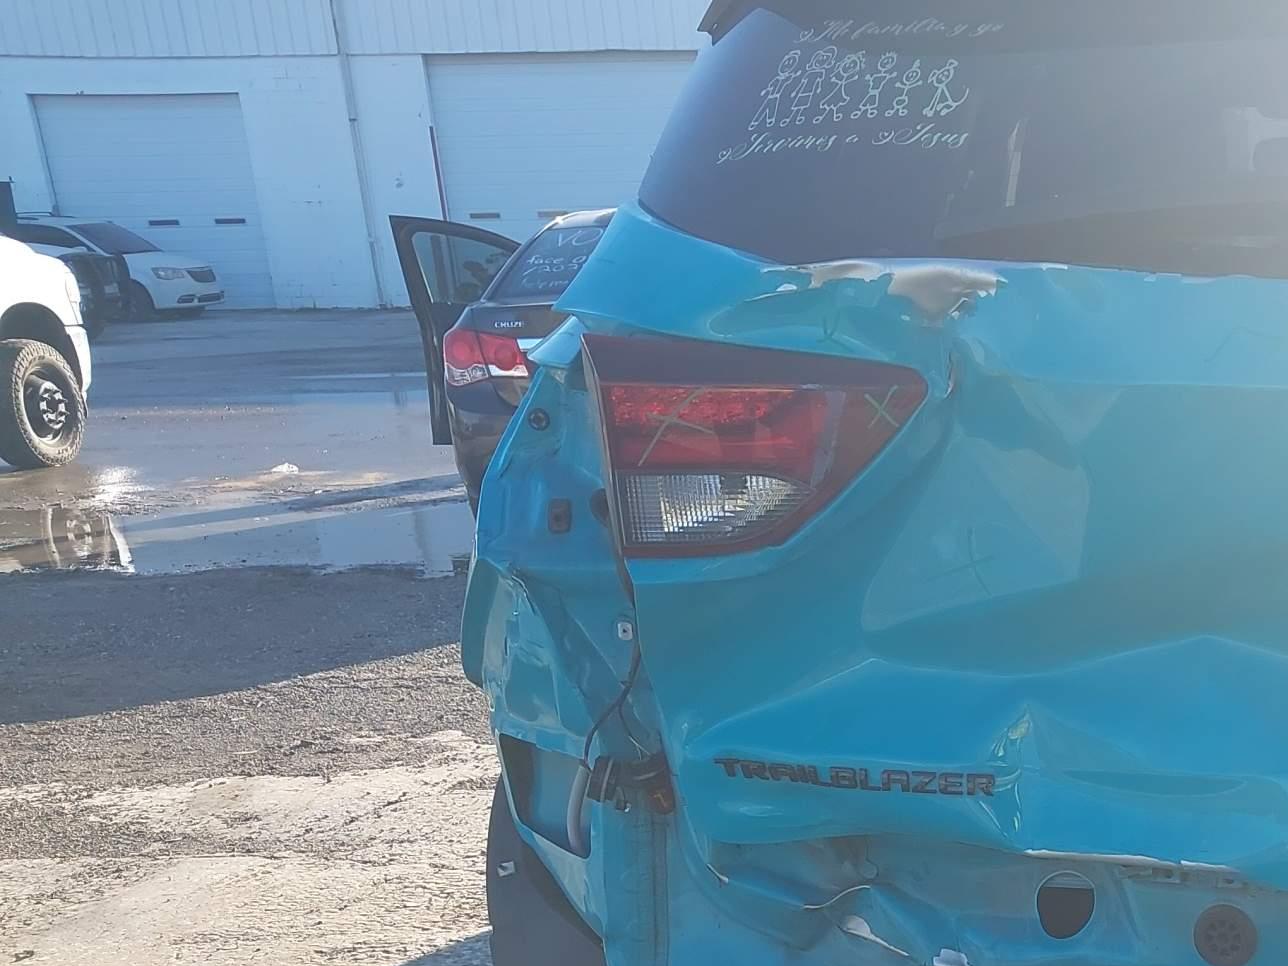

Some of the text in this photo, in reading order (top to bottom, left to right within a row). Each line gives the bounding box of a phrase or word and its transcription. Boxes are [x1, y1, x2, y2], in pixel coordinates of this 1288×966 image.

[845, 135, 859, 144] a
[494, 321, 525, 329] CRUZE
[714, 757, 996, 797] TRAILBLAZER
